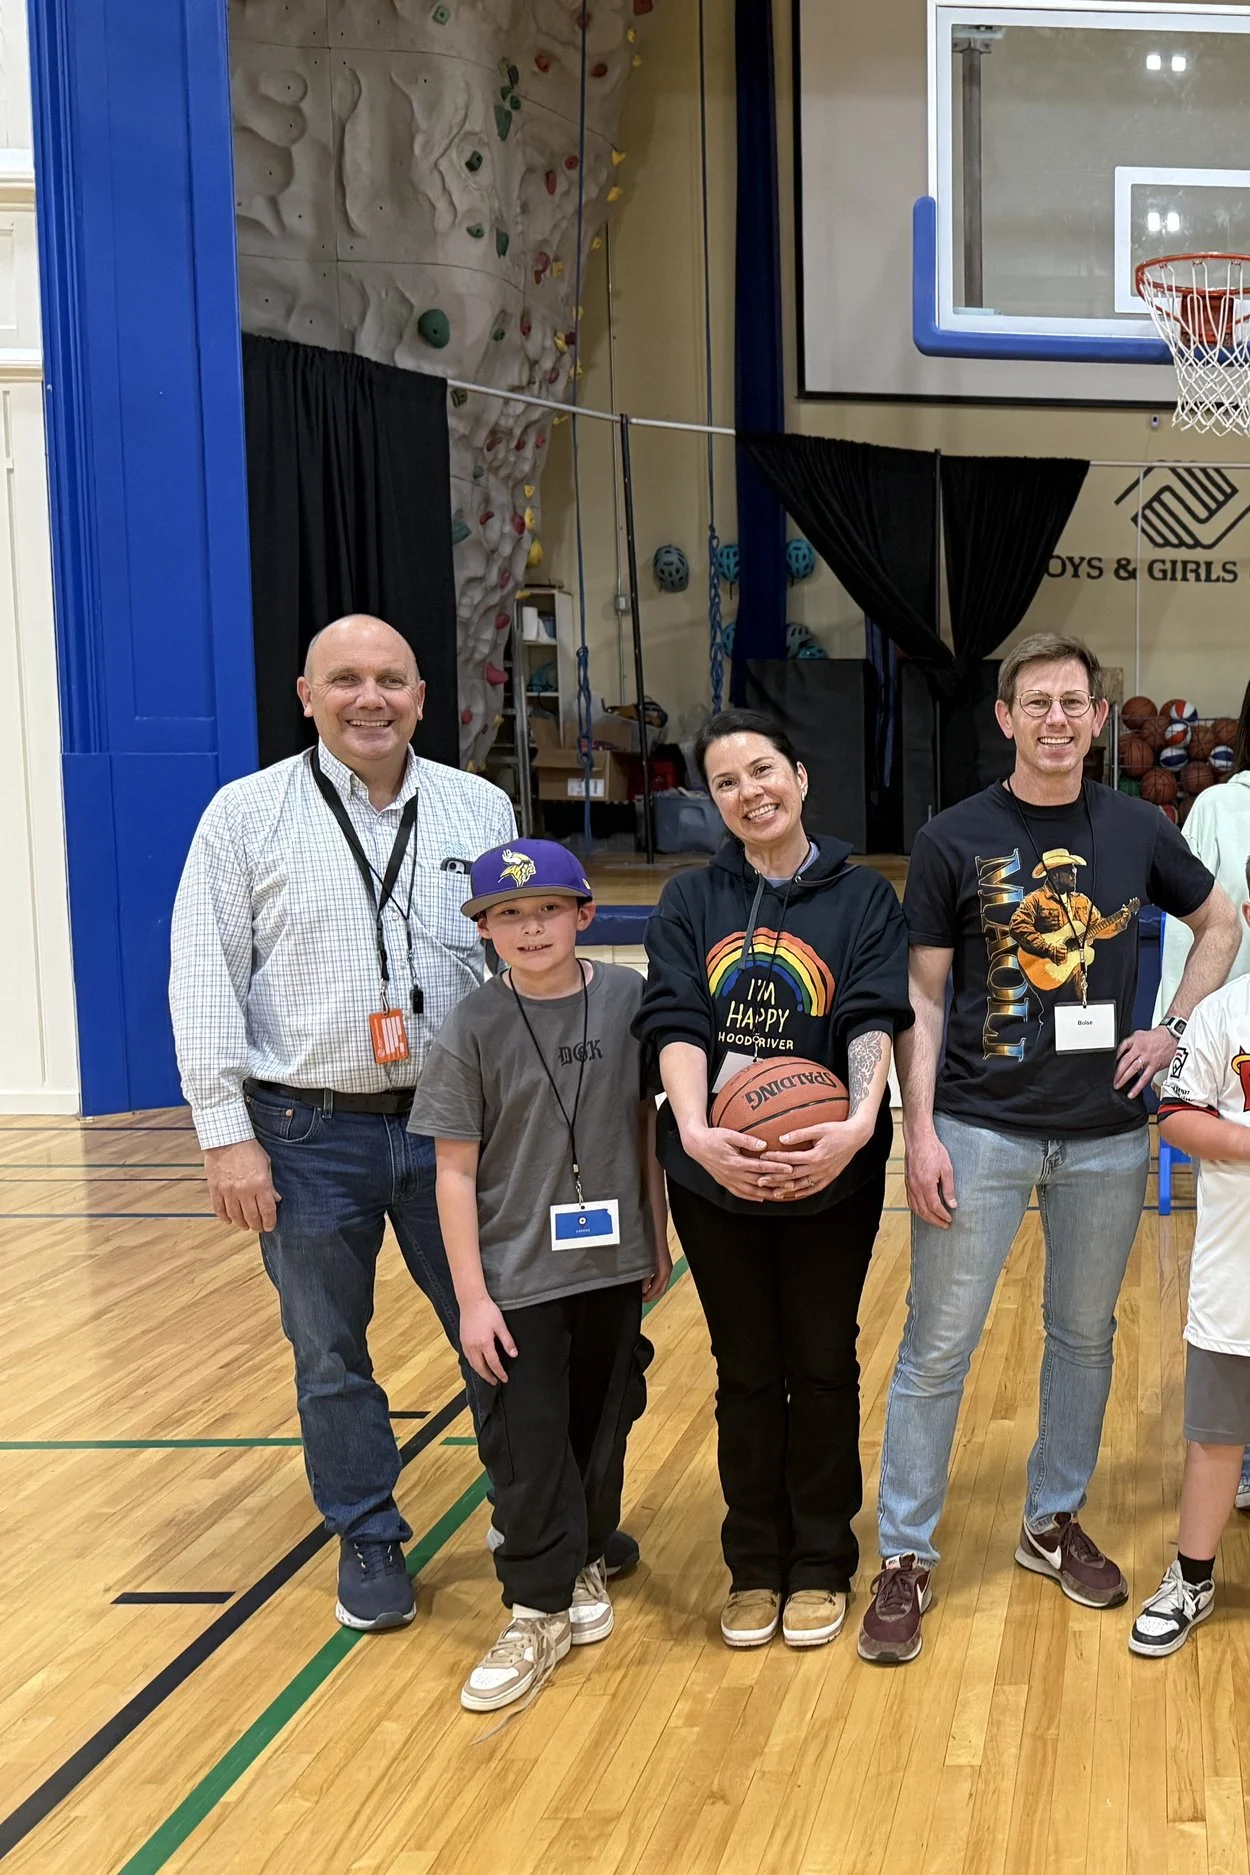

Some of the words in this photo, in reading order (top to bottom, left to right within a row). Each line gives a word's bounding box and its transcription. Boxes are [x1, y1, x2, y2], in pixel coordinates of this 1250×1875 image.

[1046, 555, 1103, 580] OYS
[1113, 557, 1138, 581] &
[1147, 559, 1238, 583] GIRLS
[975, 848, 1030, 1062] MAOLI
[747, 978, 776, 1006] I'M
[725, 1000, 790, 1033] HAPPY
[718, 1031, 752, 1046] HOOD
[758, 1037, 794, 1050] RIVER
[744, 1070, 838, 1112] SPALDING
